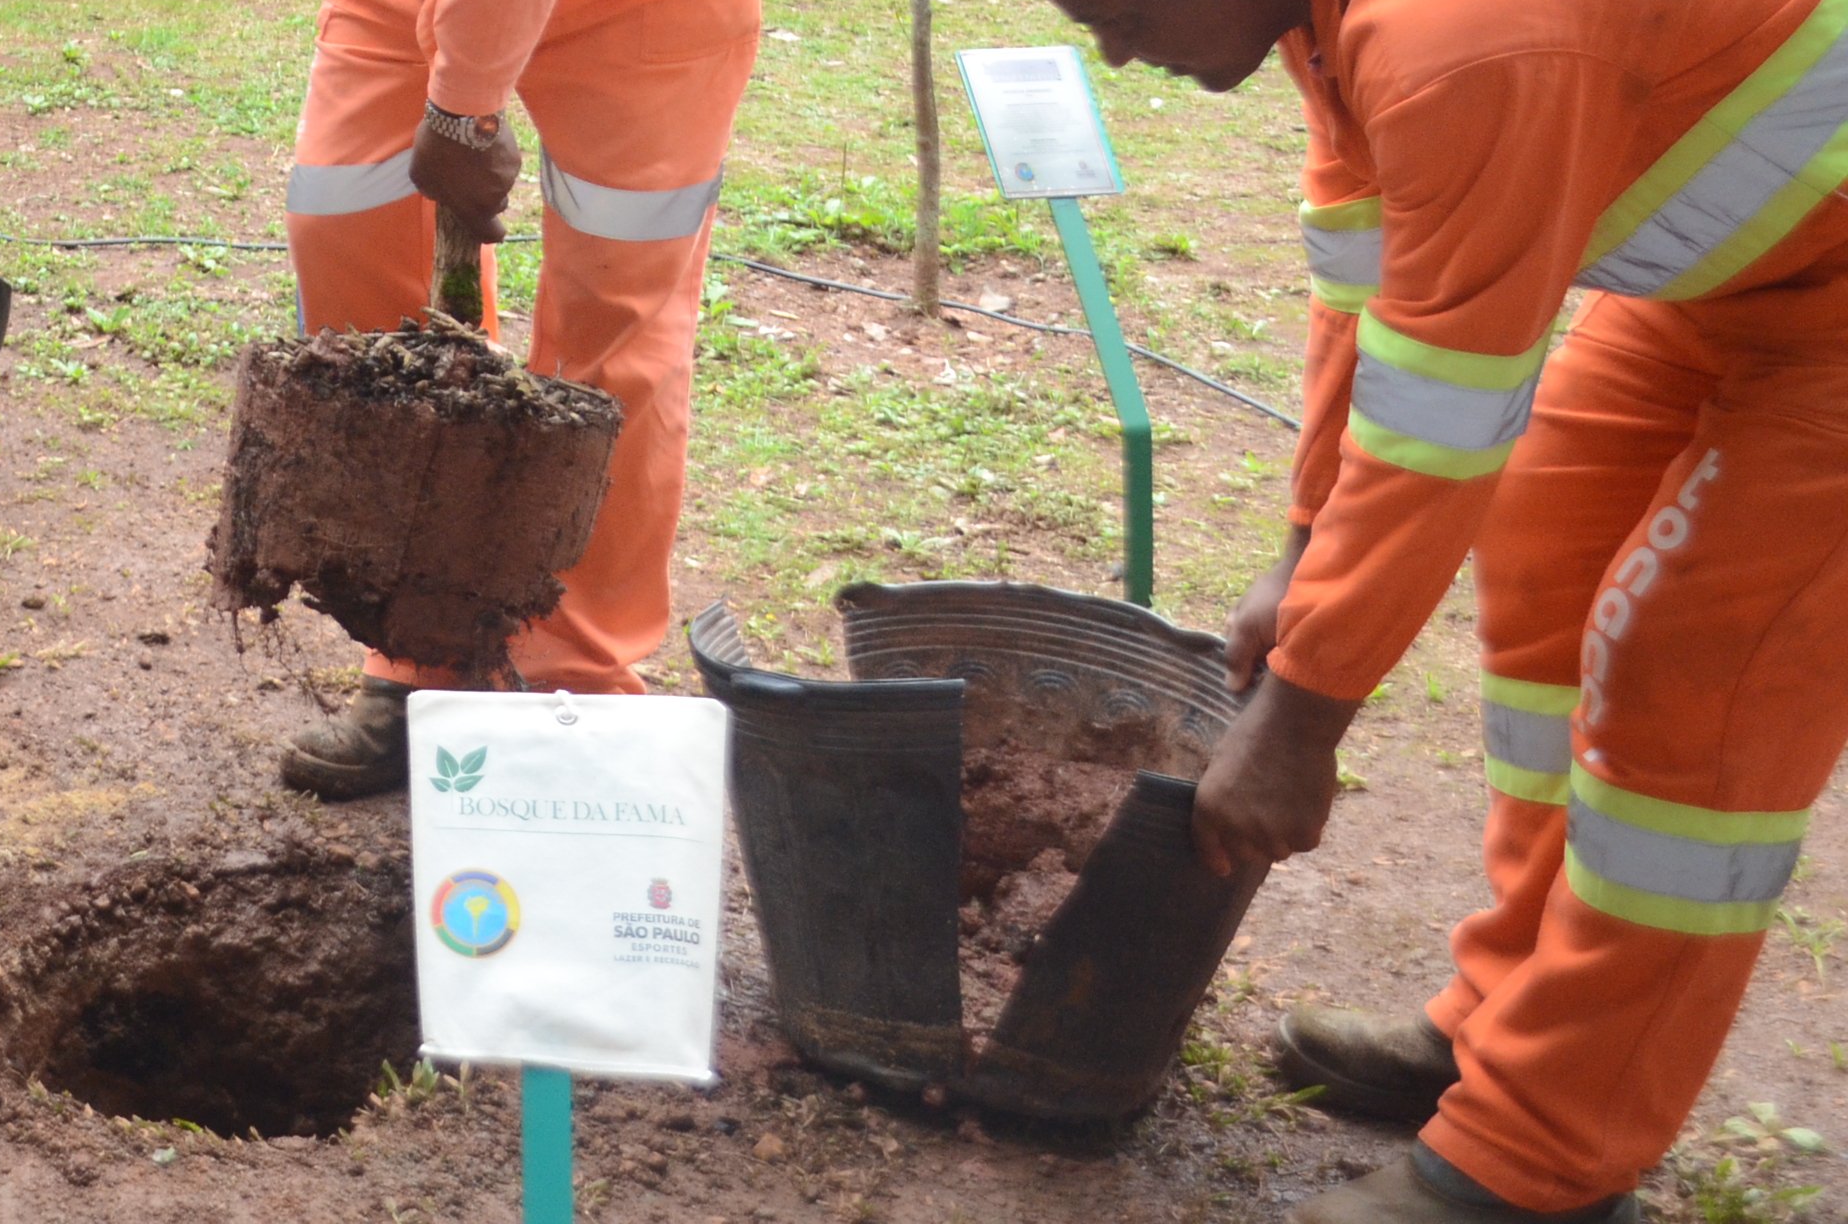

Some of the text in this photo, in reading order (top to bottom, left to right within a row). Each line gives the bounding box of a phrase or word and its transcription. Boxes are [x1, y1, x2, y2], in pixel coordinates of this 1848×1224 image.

[459, 796, 686, 826] BOSQUE DA FAMA
[613, 912, 701, 929] PREFEITURA DE
[613, 923, 700, 945] SÃO PAULO
[631, 942, 688, 956] ESPORTES
